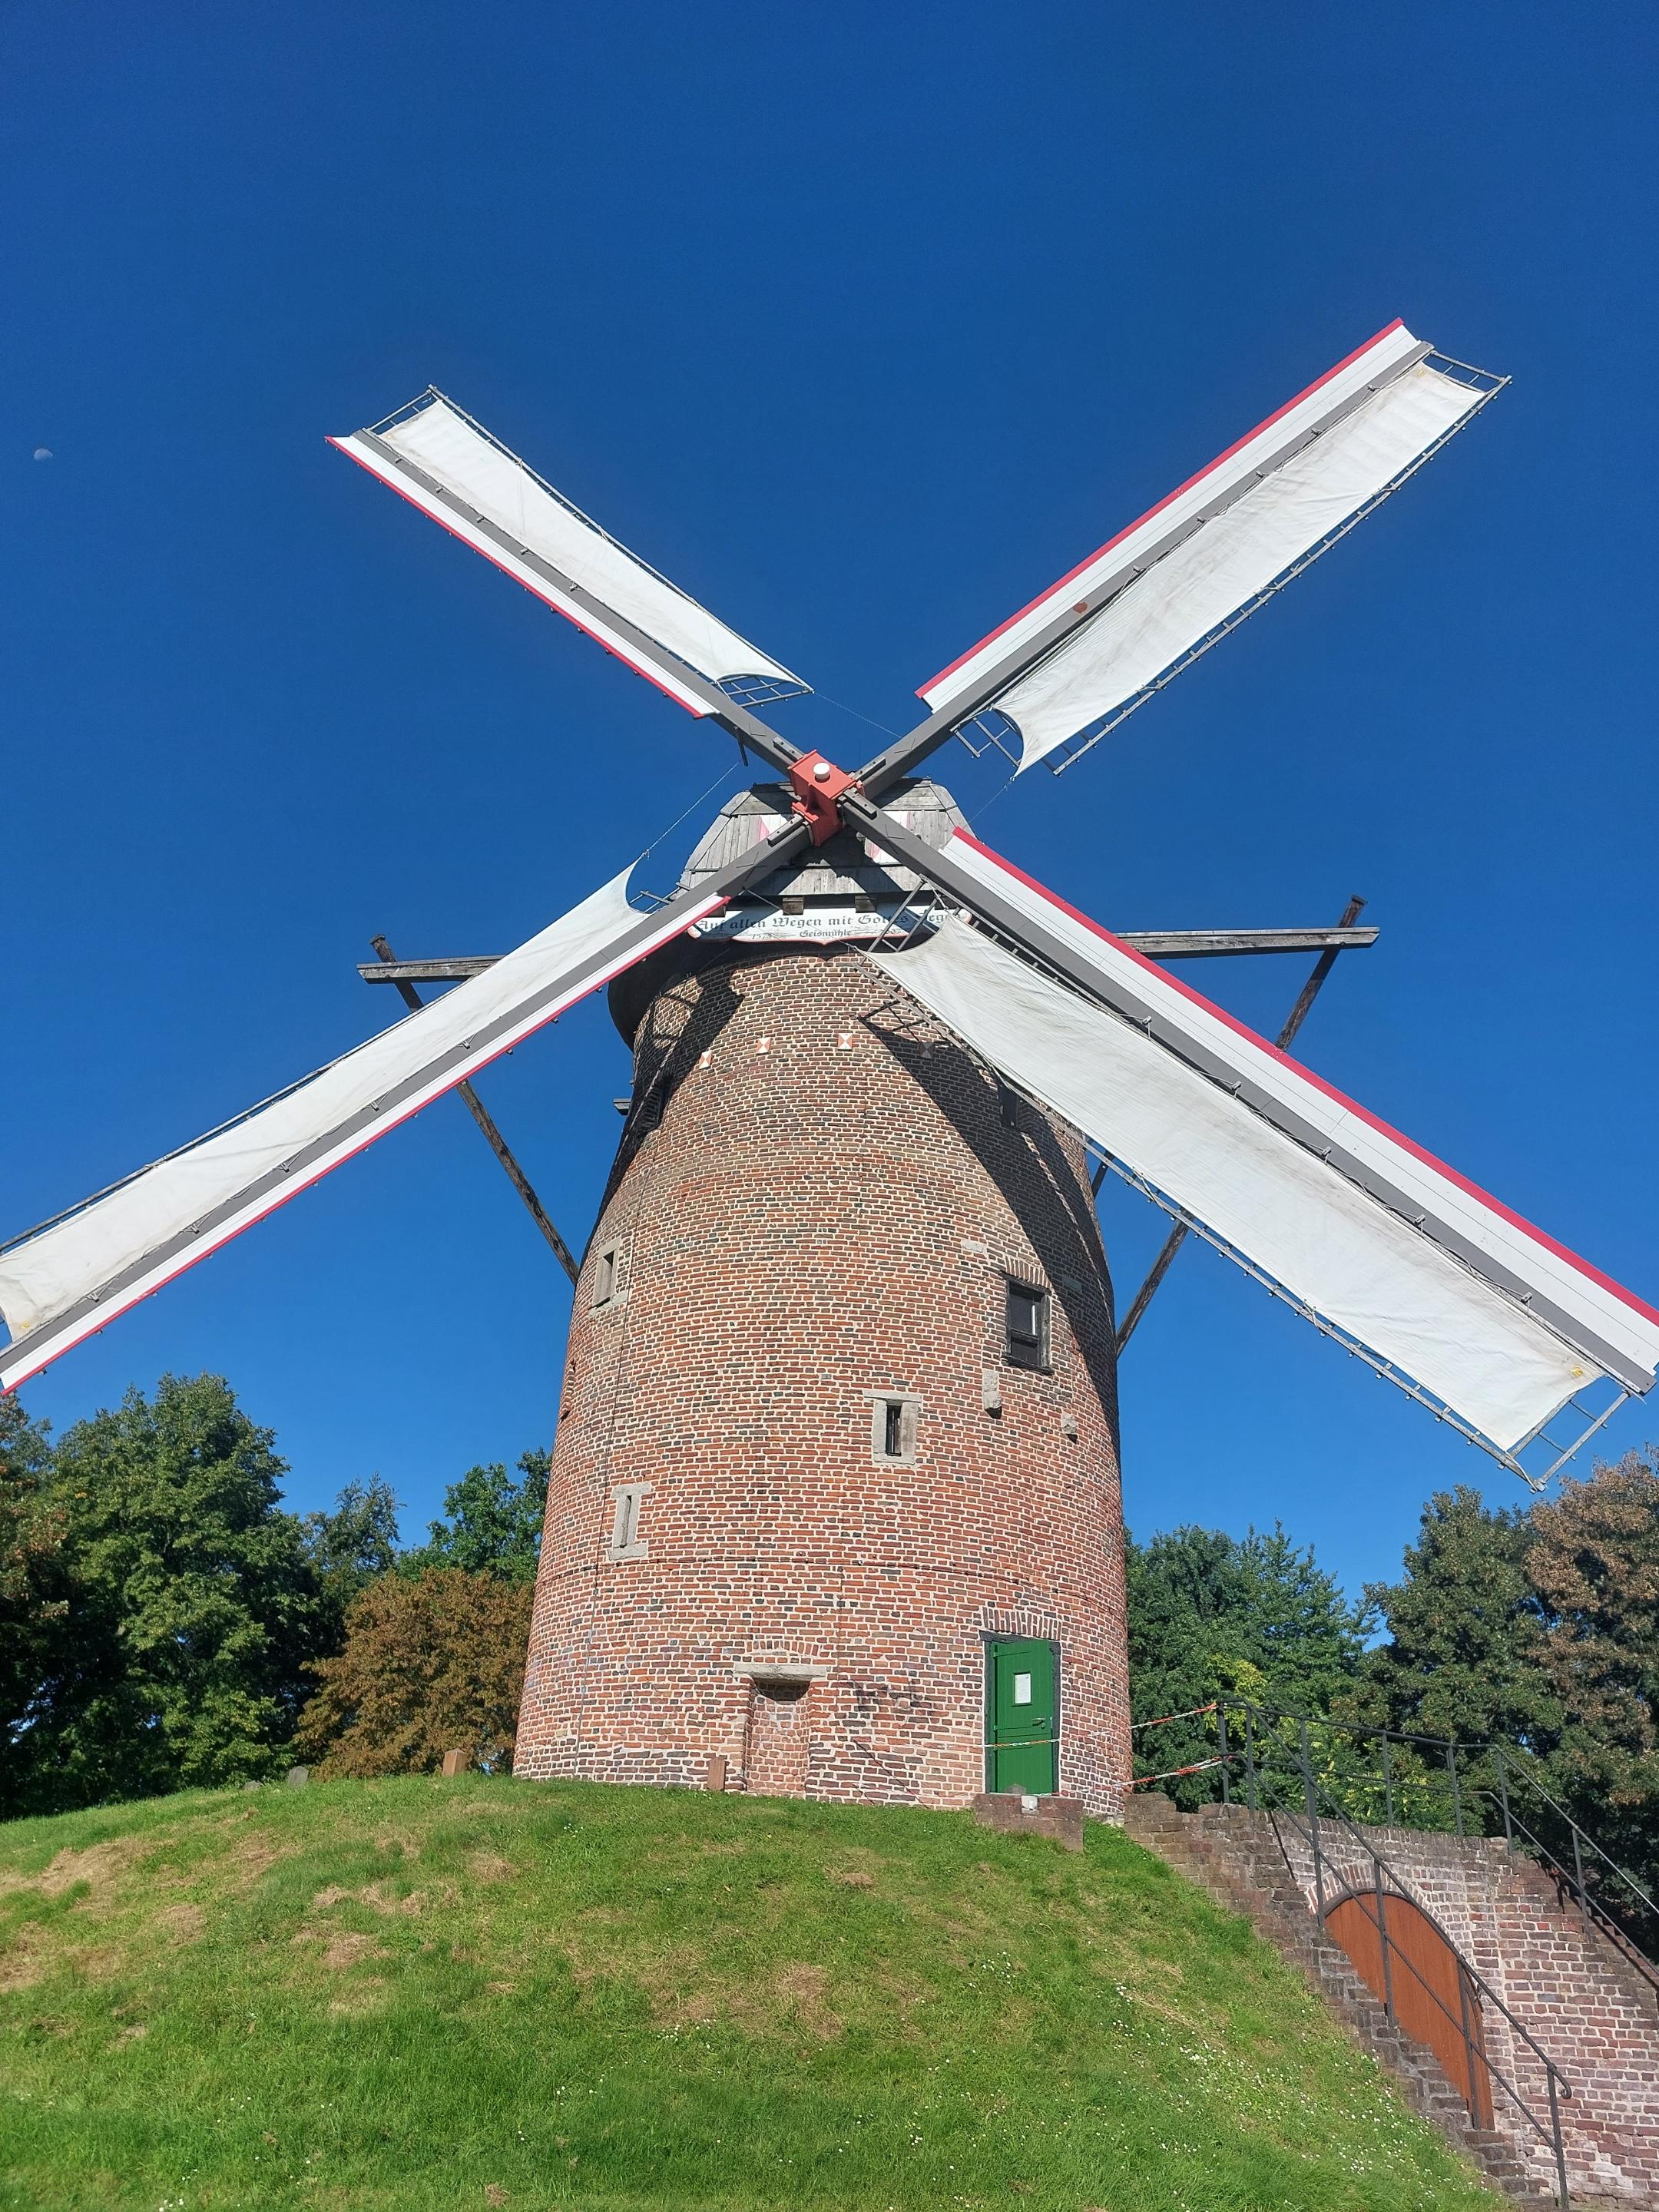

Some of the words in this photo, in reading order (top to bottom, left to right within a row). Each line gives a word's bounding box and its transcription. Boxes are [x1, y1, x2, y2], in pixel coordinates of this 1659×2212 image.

[730, 918, 766, 929] allen
[773, 917, 822, 929] Wegen
[828, 916, 854, 926] mit
[799, 928, 853, 938] Geismühle
